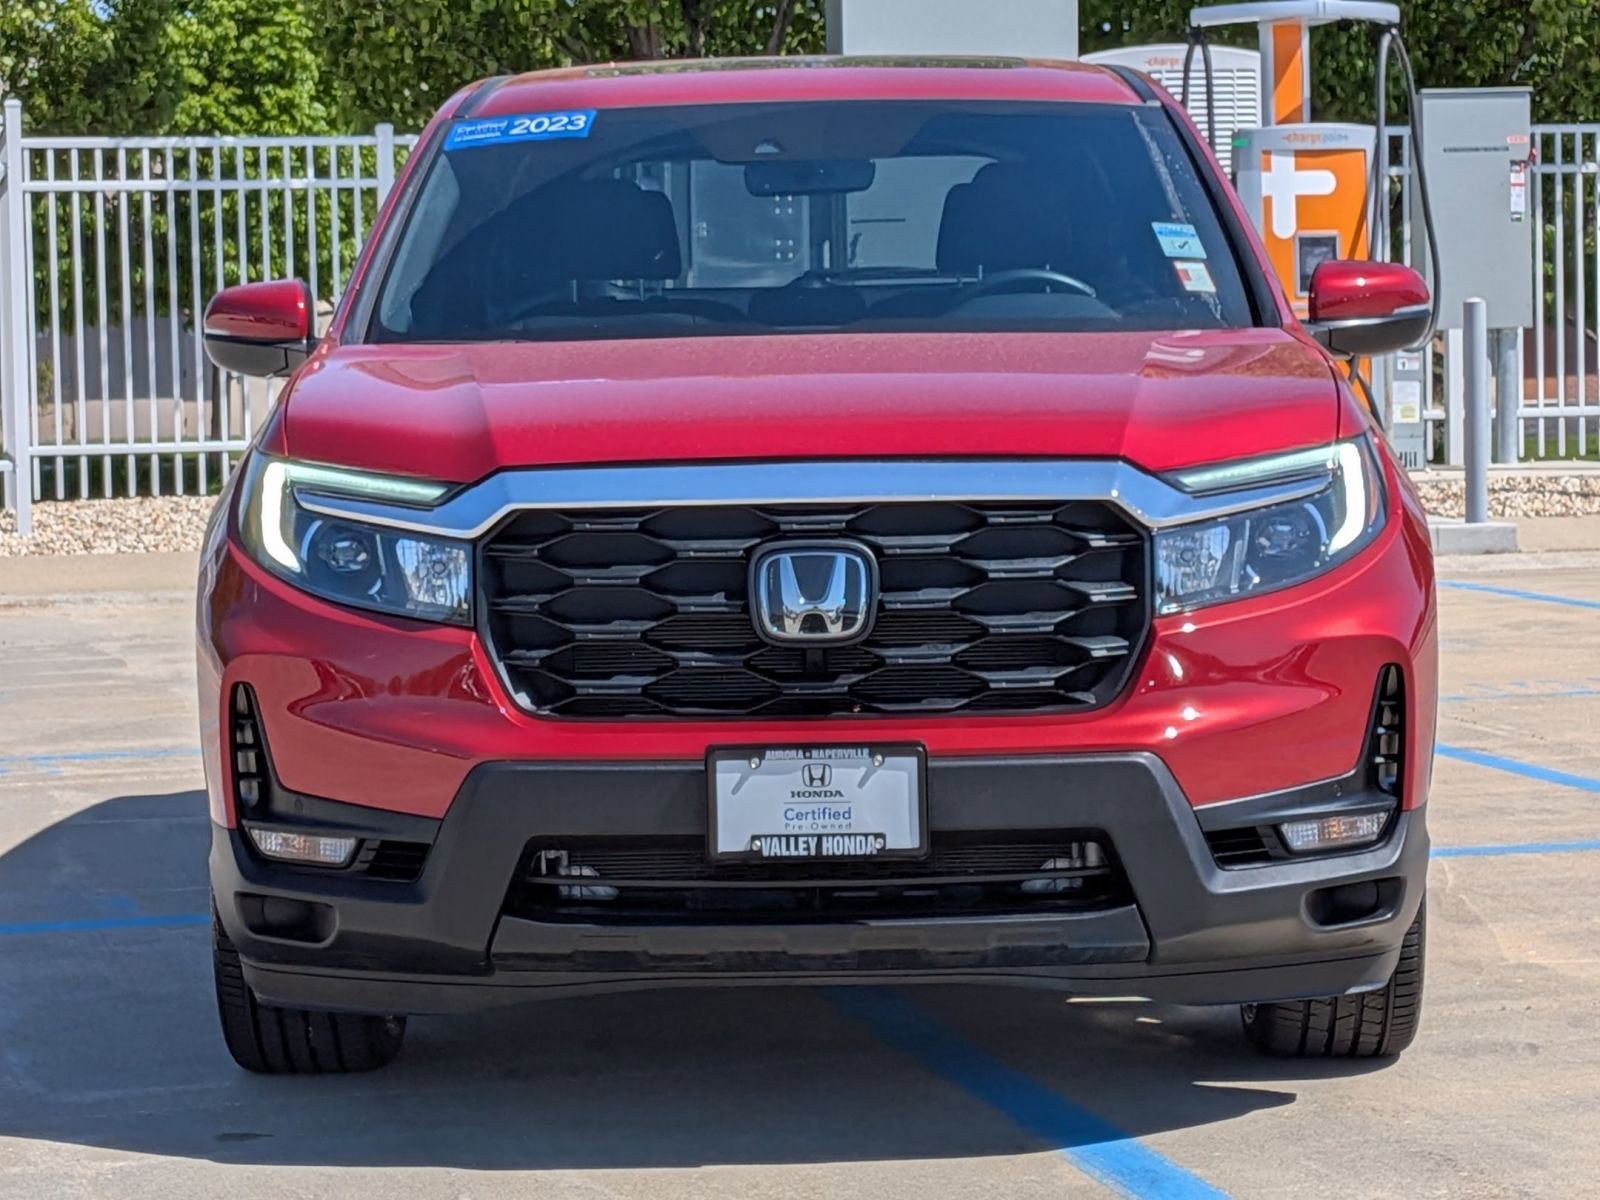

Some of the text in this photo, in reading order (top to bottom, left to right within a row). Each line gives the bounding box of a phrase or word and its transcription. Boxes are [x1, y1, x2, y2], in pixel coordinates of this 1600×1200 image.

[509, 115, 587, 135] 2023
[811, 748, 869, 759] NAPERVILLE
[790, 790, 844, 798] HONDA
[784, 807, 852, 821] Certified
[785, 822, 852, 830] Pre-Owned
[761, 834, 877, 857] VALLEY HONDA
